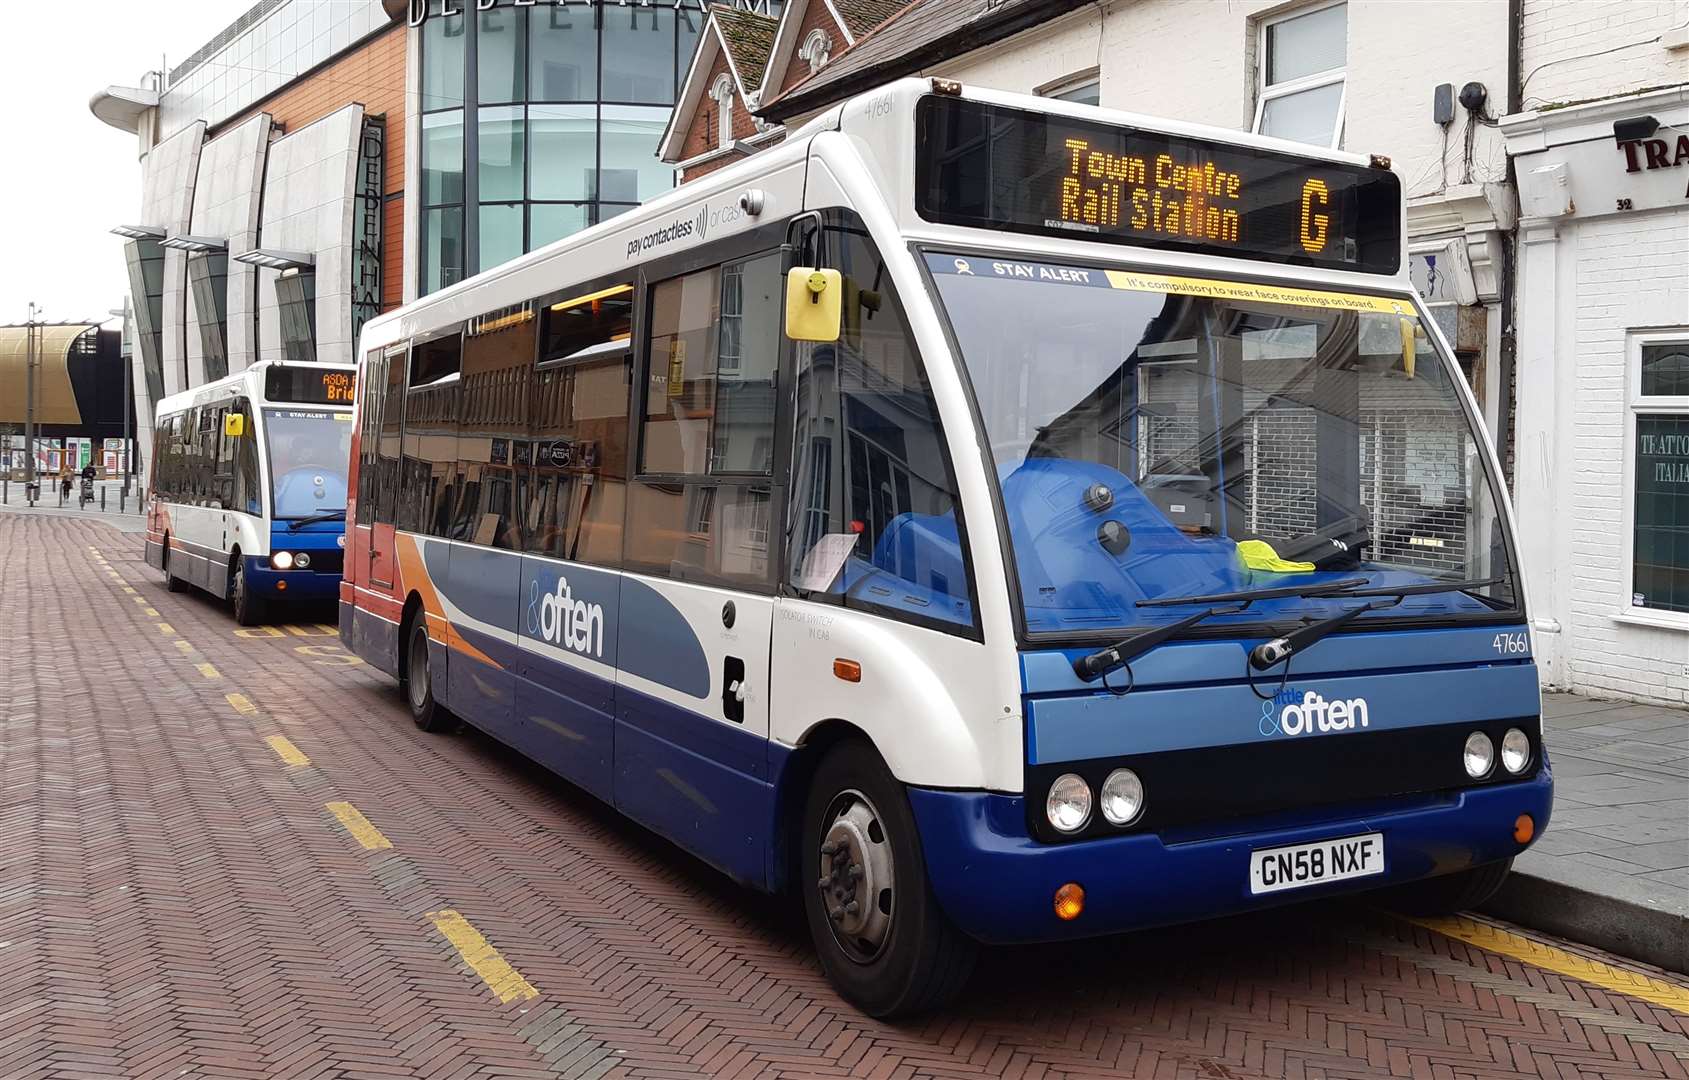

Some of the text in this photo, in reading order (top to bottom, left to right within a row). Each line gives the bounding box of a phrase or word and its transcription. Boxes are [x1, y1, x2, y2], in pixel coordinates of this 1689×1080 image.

[864, 92, 893, 120] 47661
[1065, 138, 1240, 199] Town Centre
[1616, 135, 1689, 173] TRA
[1062, 176, 1239, 242] Rail Station
[1300, 178, 1329, 252] G
[1616, 198, 1633, 211] 32
[627, 238, 642, 260] pay
[642, 219, 693, 250] contactless
[710, 210, 720, 228] or
[992, 262, 1377, 309] STAY ALERT It's compulsory to wear face coverings on board.
[323, 374, 348, 386] ASDA
[327, 385, 354, 401] Brid
[541, 576, 603, 658] often
[1493, 632, 1528, 655] 47661
[1273, 687, 1304, 704] little
[1281, 691, 1369, 736] often
[1262, 840, 1373, 886] GN58 NXF
